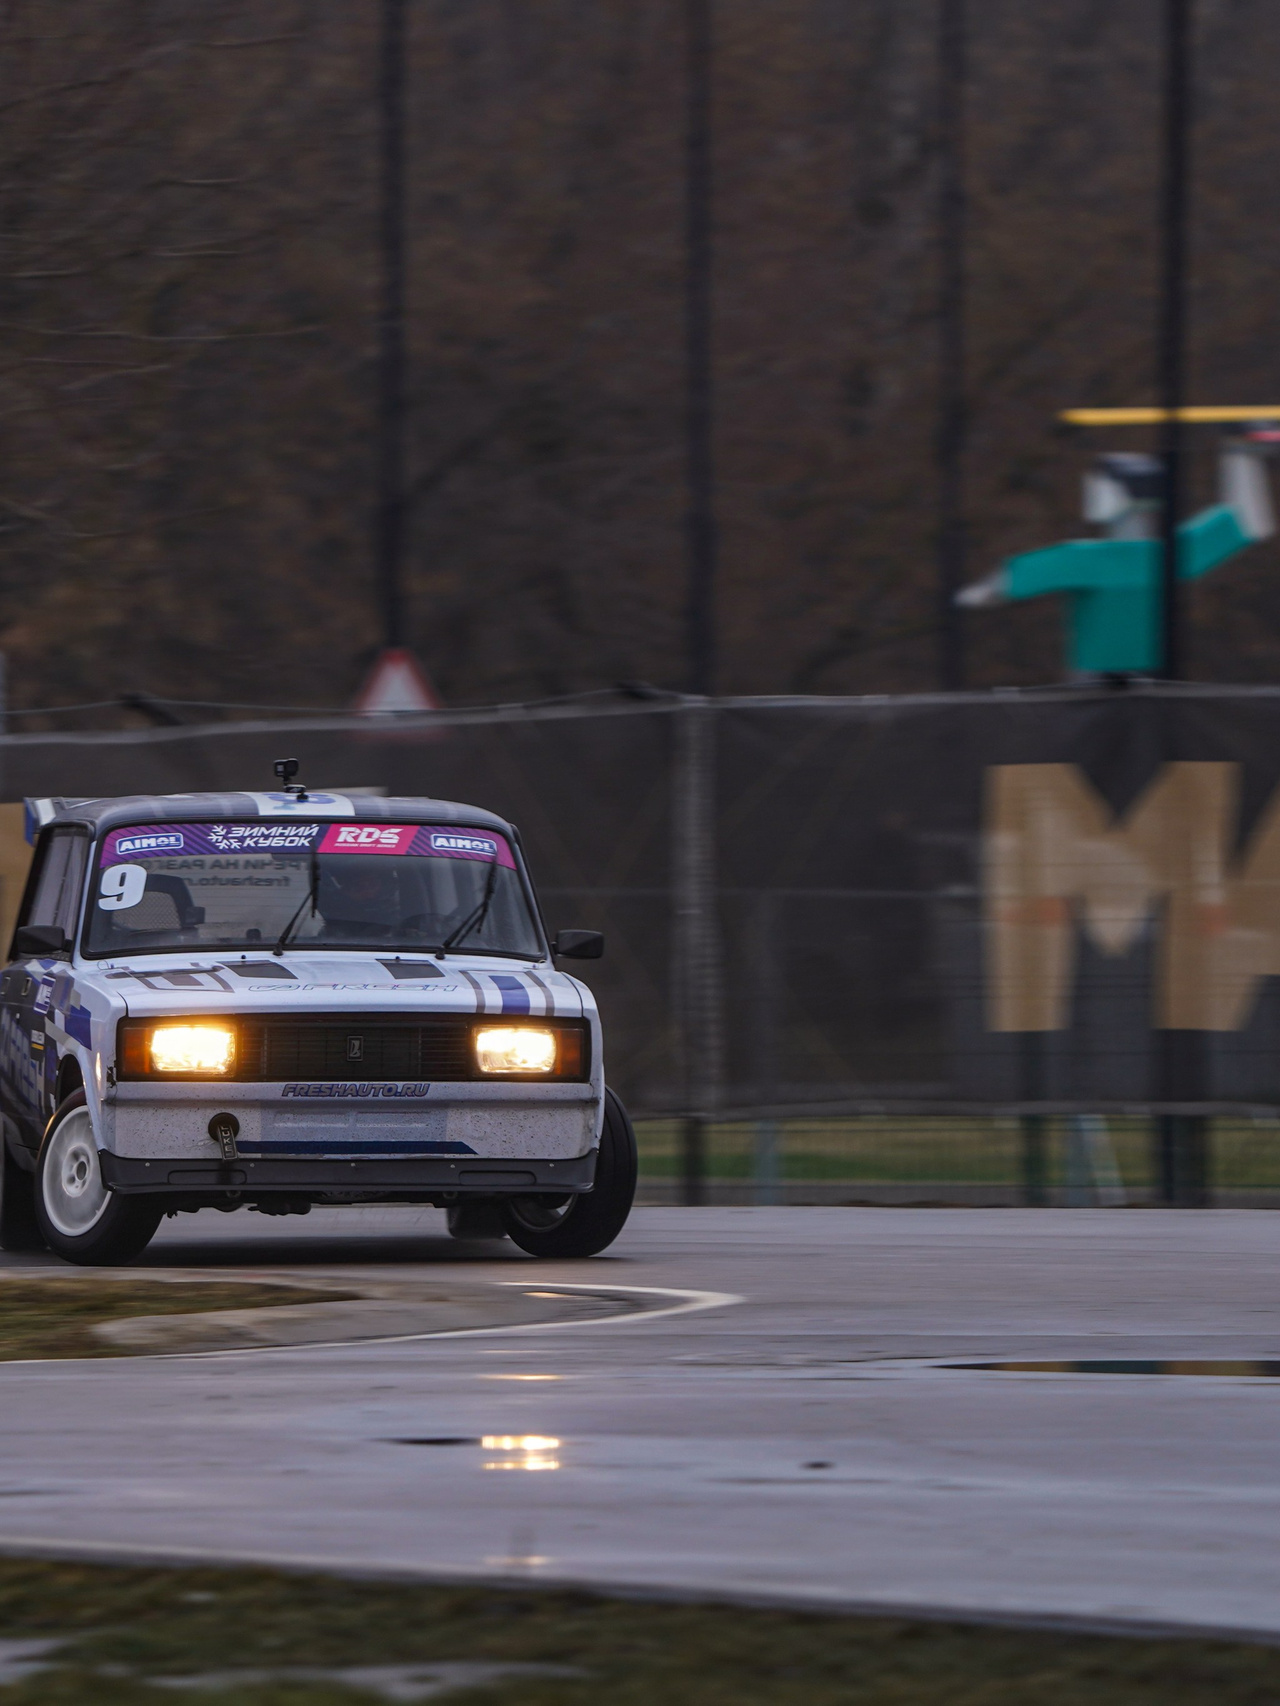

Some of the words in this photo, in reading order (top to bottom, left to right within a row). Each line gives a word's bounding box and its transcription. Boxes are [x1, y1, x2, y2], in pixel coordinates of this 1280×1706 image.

[229, 824, 319, 836] ЗИМНИЙ
[336, 827, 403, 843] RDS
[119, 836, 181, 852] AIMOL
[243, 836, 313, 847] КУБОК
[434, 837, 495, 852] AIMOL
[98, 863, 148, 910] 9
[281, 1083, 431, 1098] FRESHAUTO.RU
